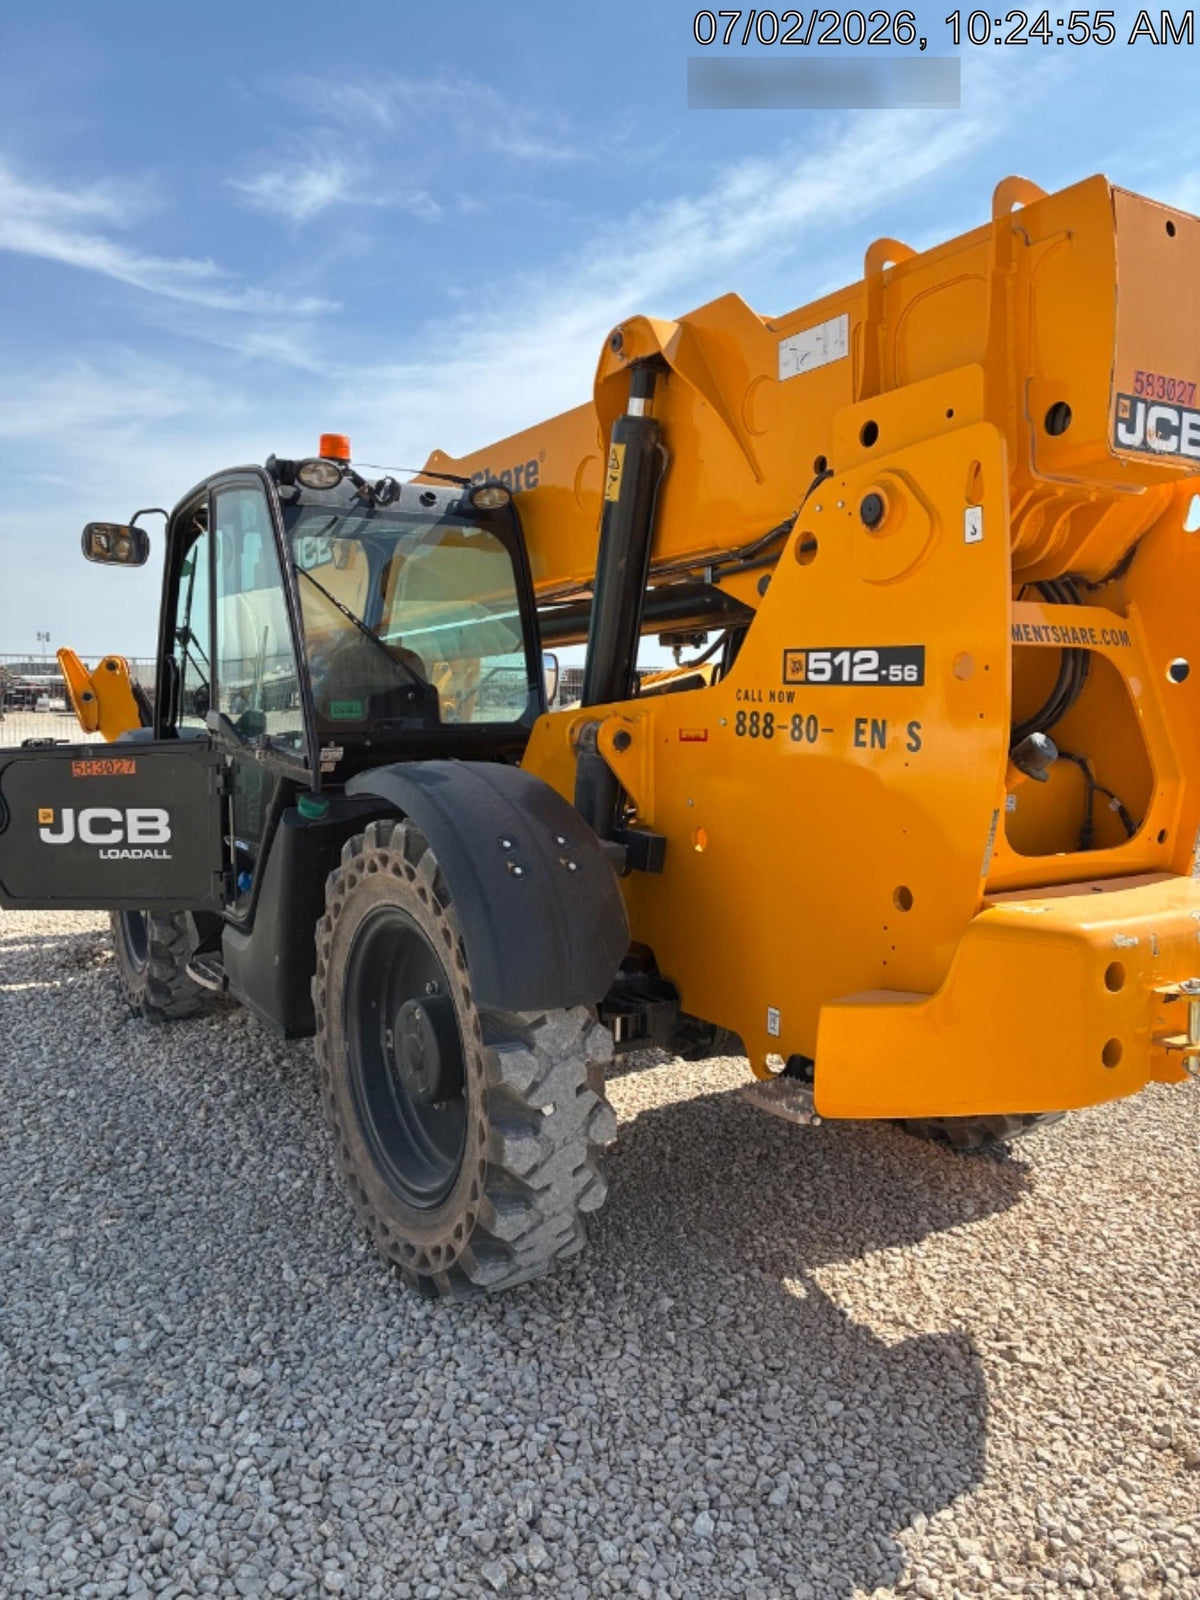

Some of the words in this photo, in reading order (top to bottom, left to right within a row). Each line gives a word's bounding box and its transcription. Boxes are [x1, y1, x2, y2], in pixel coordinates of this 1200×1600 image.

[1134, 370, 1197, 405] 583027
[736, 689, 764, 703] CALL
[769, 690, 796, 704] NOW
[39, 808, 172, 844] JCB
[98, 849, 173, 860] LOADALL
